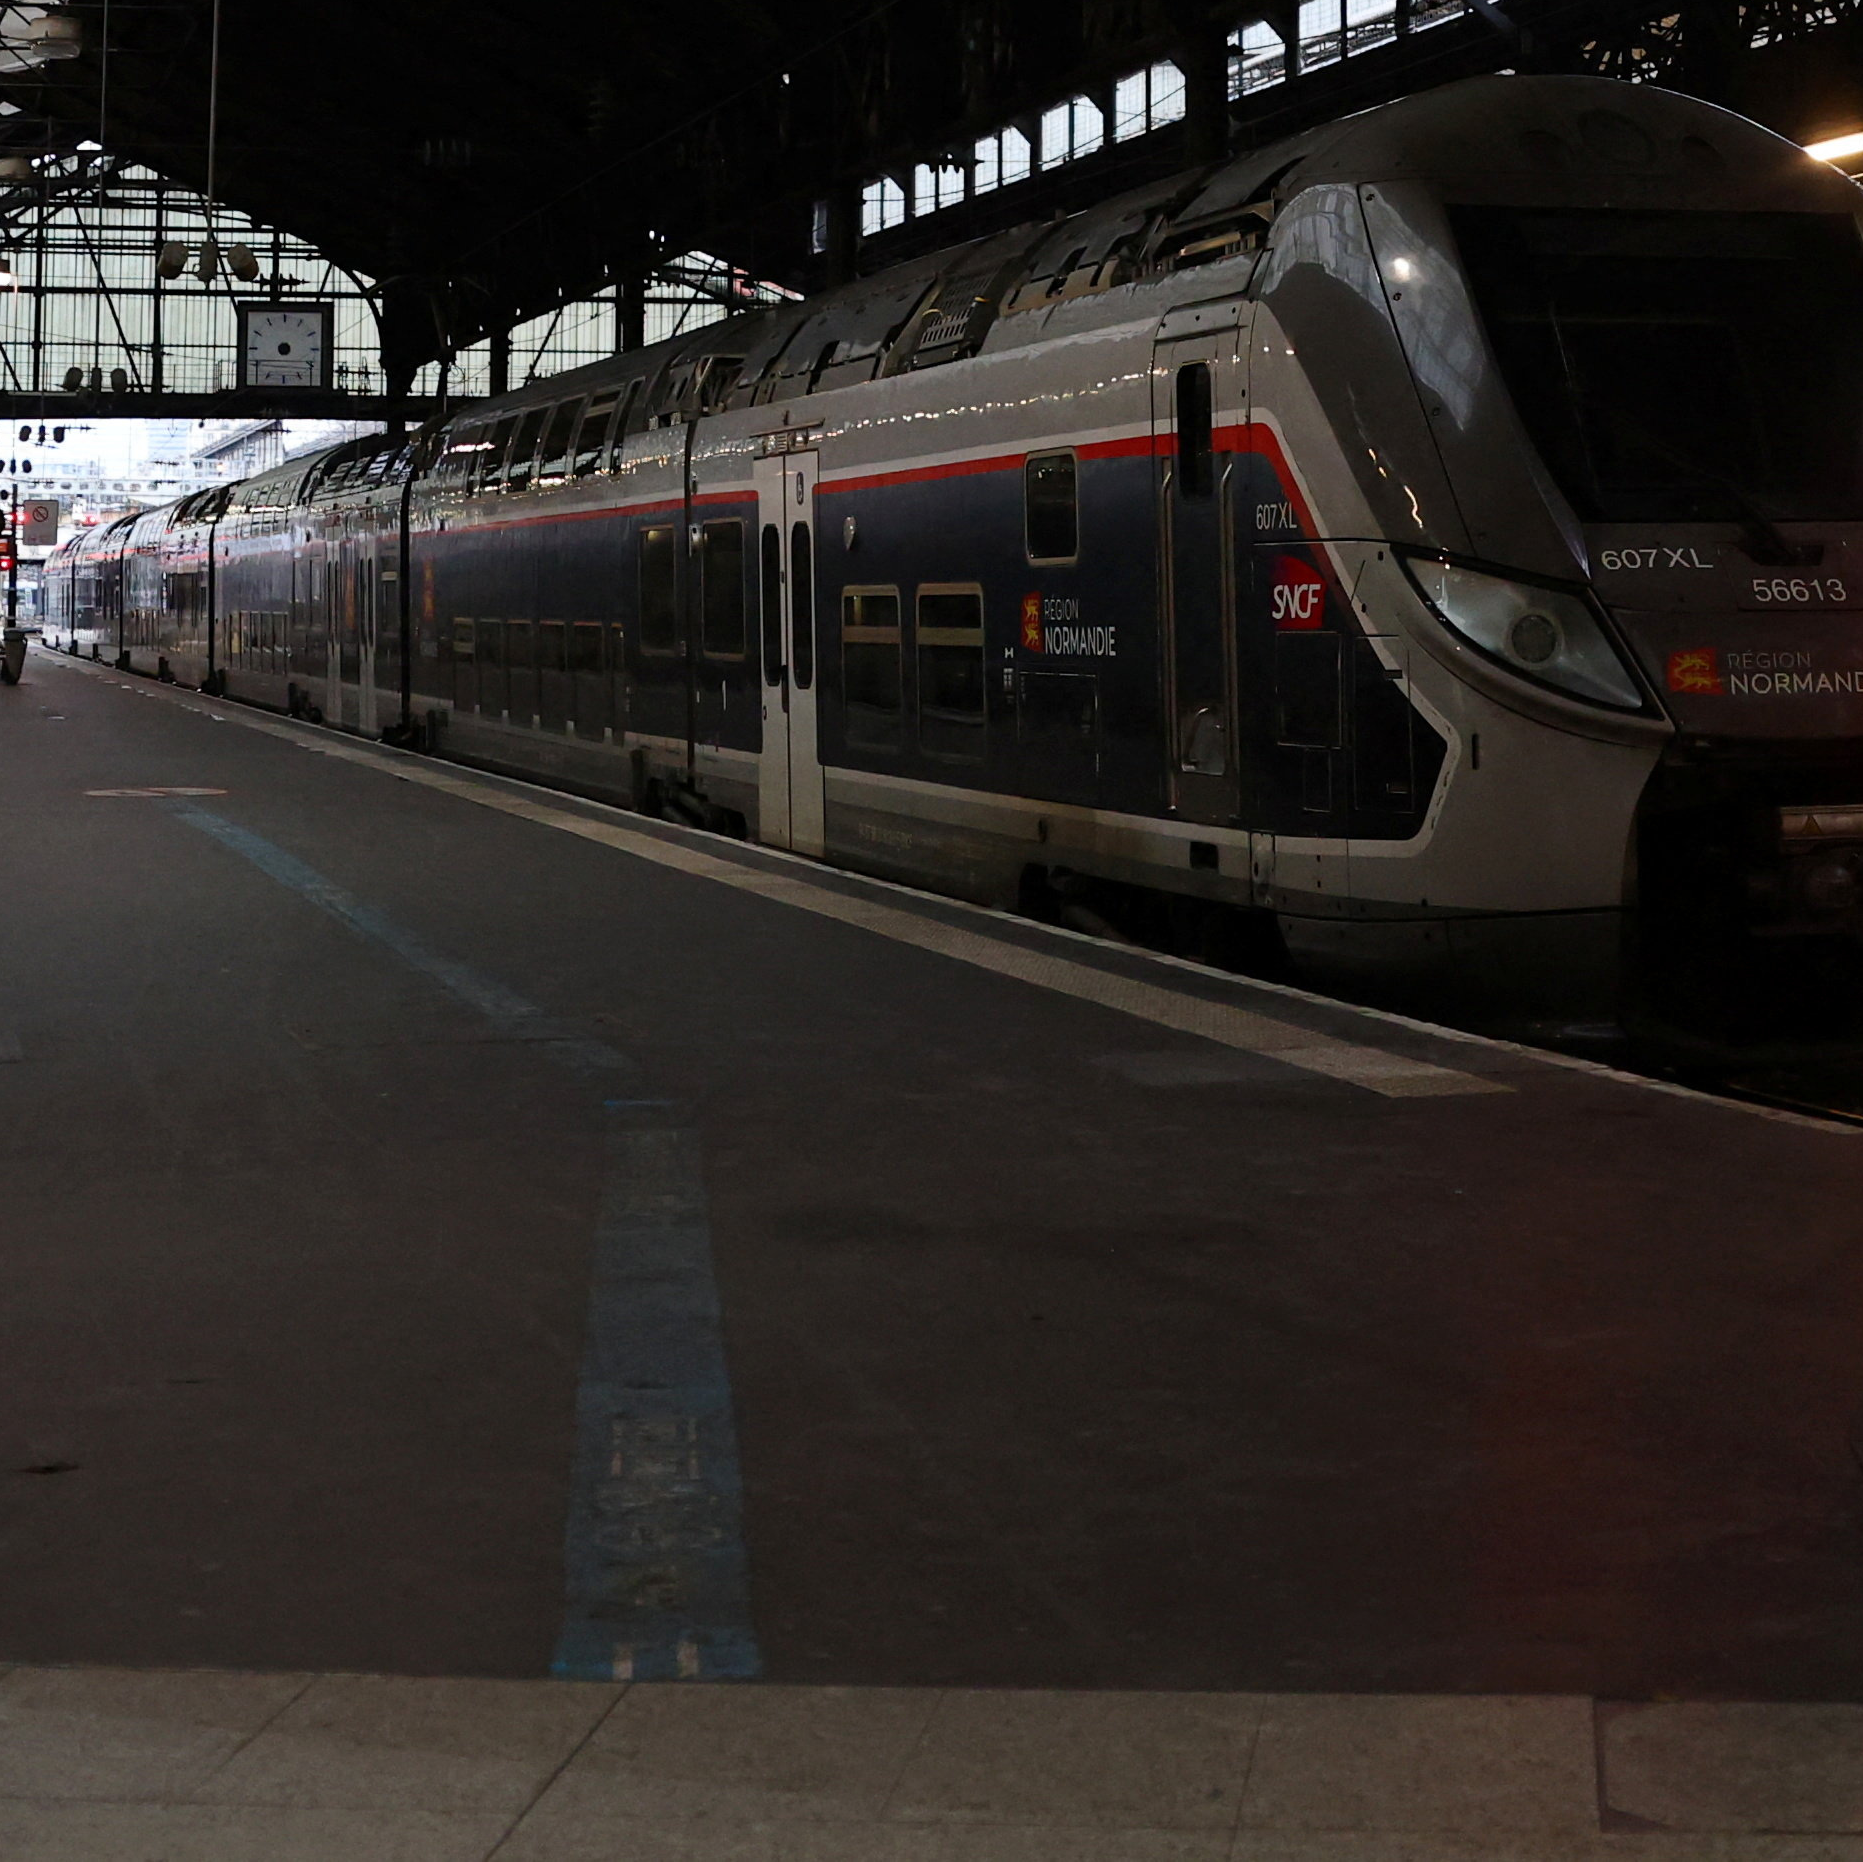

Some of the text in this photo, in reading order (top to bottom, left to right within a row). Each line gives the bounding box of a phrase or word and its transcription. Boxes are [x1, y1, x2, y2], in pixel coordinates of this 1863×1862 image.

[1255, 501, 1298, 531] 607XL
[1600, 546, 1714, 571] 607XL
[1271, 583, 1322, 620] SNCF
[1751, 578, 1848, 603] 56613
[1043, 593, 1080, 621] RÉGION
[1044, 625, 1117, 657] NORMANDIE
[1726, 649, 1812, 670] RÉGION
